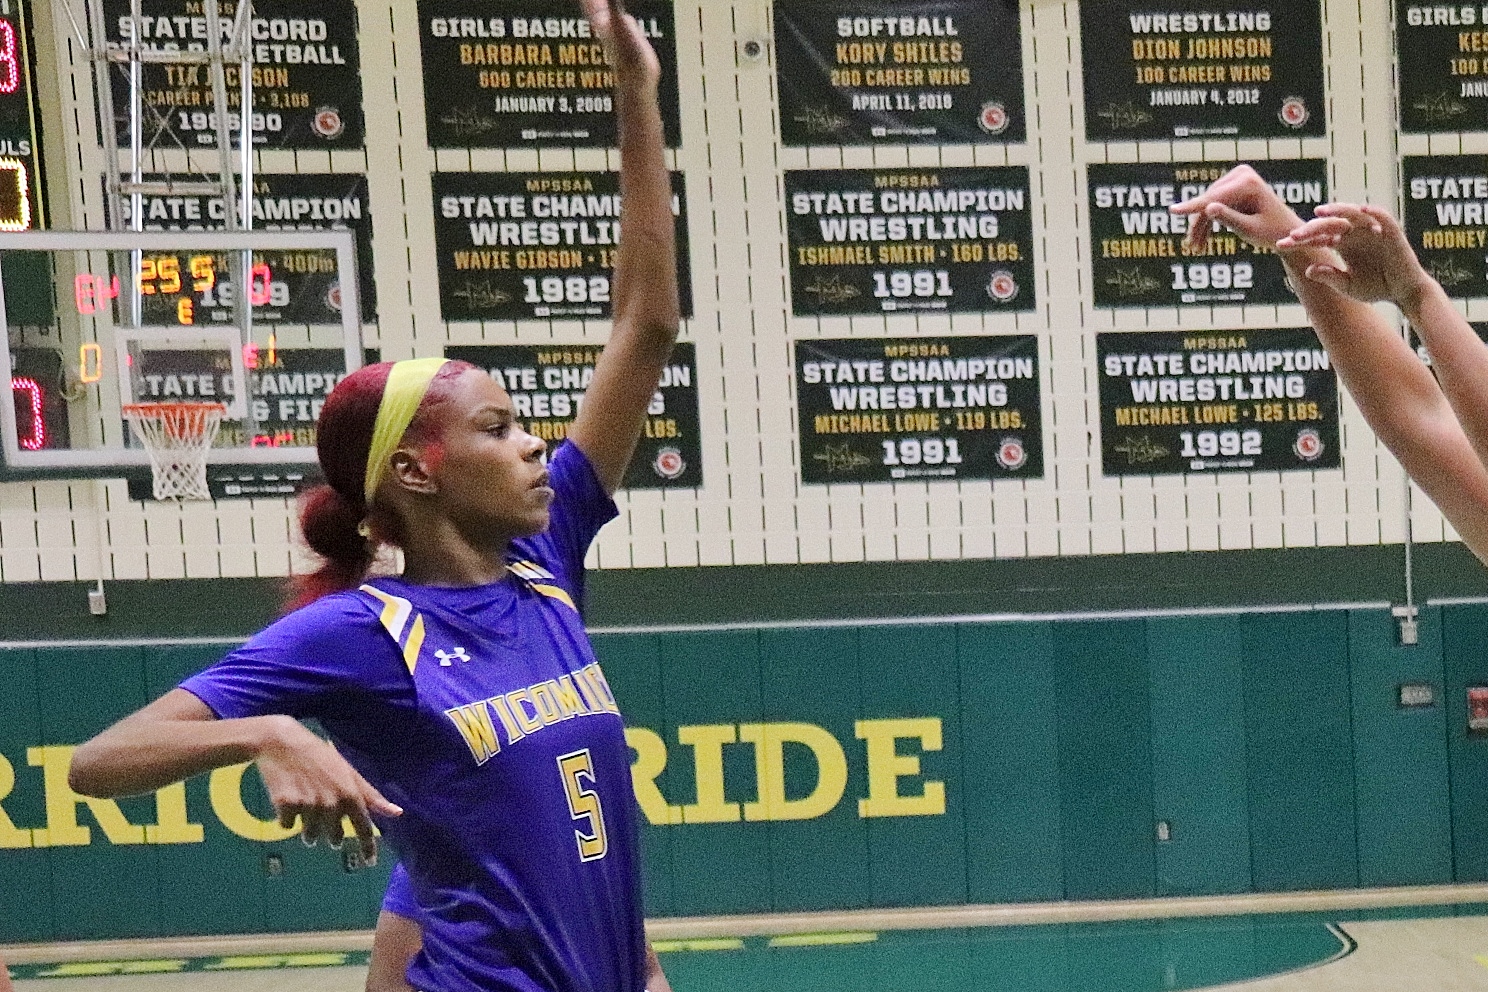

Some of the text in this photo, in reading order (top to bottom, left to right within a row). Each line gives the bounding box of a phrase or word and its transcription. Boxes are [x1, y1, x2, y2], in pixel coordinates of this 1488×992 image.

[837, 16, 958, 37] SOFTBALL
[1129, 12, 1272, 34] WRESTLING
[1407, 6, 1475, 26] GIRLS
[218, 17, 328, 41] RCORD
[431, 17, 663, 39] GIRLS BASKELL
[460, 43, 552, 65] BARBARA
[836, 41, 962, 64] KORY SHILES
[1132, 37, 1272, 60] DION JOHNSON
[831, 68, 971, 87] 200 CAREER WINS
[1136, 65, 1272, 84] 100 CAREER WINS
[1450, 58, 1478, 75] 100
[516, 70, 575, 88] CAREER
[494, 96, 554, 112] JANUARY
[852, 94, 893, 111] APRIL
[1149, 89, 1207, 106] JANUARY
[1227, 88, 1261, 105] 2012
[526, 179, 593, 192] MPSSAA
[874, 174, 940, 188] MPSSAA
[1410, 176, 1488, 200] STATE
[441, 195, 526, 219] STATE
[793, 189, 1024, 215] STATE CHAMPION
[1095, 184, 1175, 208] STATE
[208, 198, 361, 220] CAMPION
[820, 214, 998, 241] WRESTLING
[1101, 237, 1176, 258] ISHMAEL
[1422, 229, 1486, 249] RODNEY
[454, 249, 511, 270] WAVIE
[516, 250, 583, 269] GIBSON
[799, 246, 875, 266] ISHMAEL
[879, 245, 936, 264] SMITH
[873, 270, 954, 299] 1991
[1170, 262, 1253, 290] 1992
[523, 276, 611, 304] 1982
[885, 344, 949, 358] MPSSAA
[1184, 337, 1248, 350] MPSSAA
[803, 358, 1033, 384] STATE CHAMPION
[1105, 350, 1330, 377] STATE CHAMPION
[830, 383, 1008, 411] WRESTLING
[1130, 375, 1306, 403] WRESTLING
[814, 413, 890, 434] MICHAEL
[895, 412, 940, 432] LOWE
[956, 411, 985, 430] 119
[1115, 405, 1190, 426] MICHAEL
[1194, 403, 1238, 424] LOWE
[1254, 403, 1283, 422] 125
[882, 438, 962, 466] 1991
[1180, 429, 1262, 457] 1992
[557, 748, 608, 862] 5
